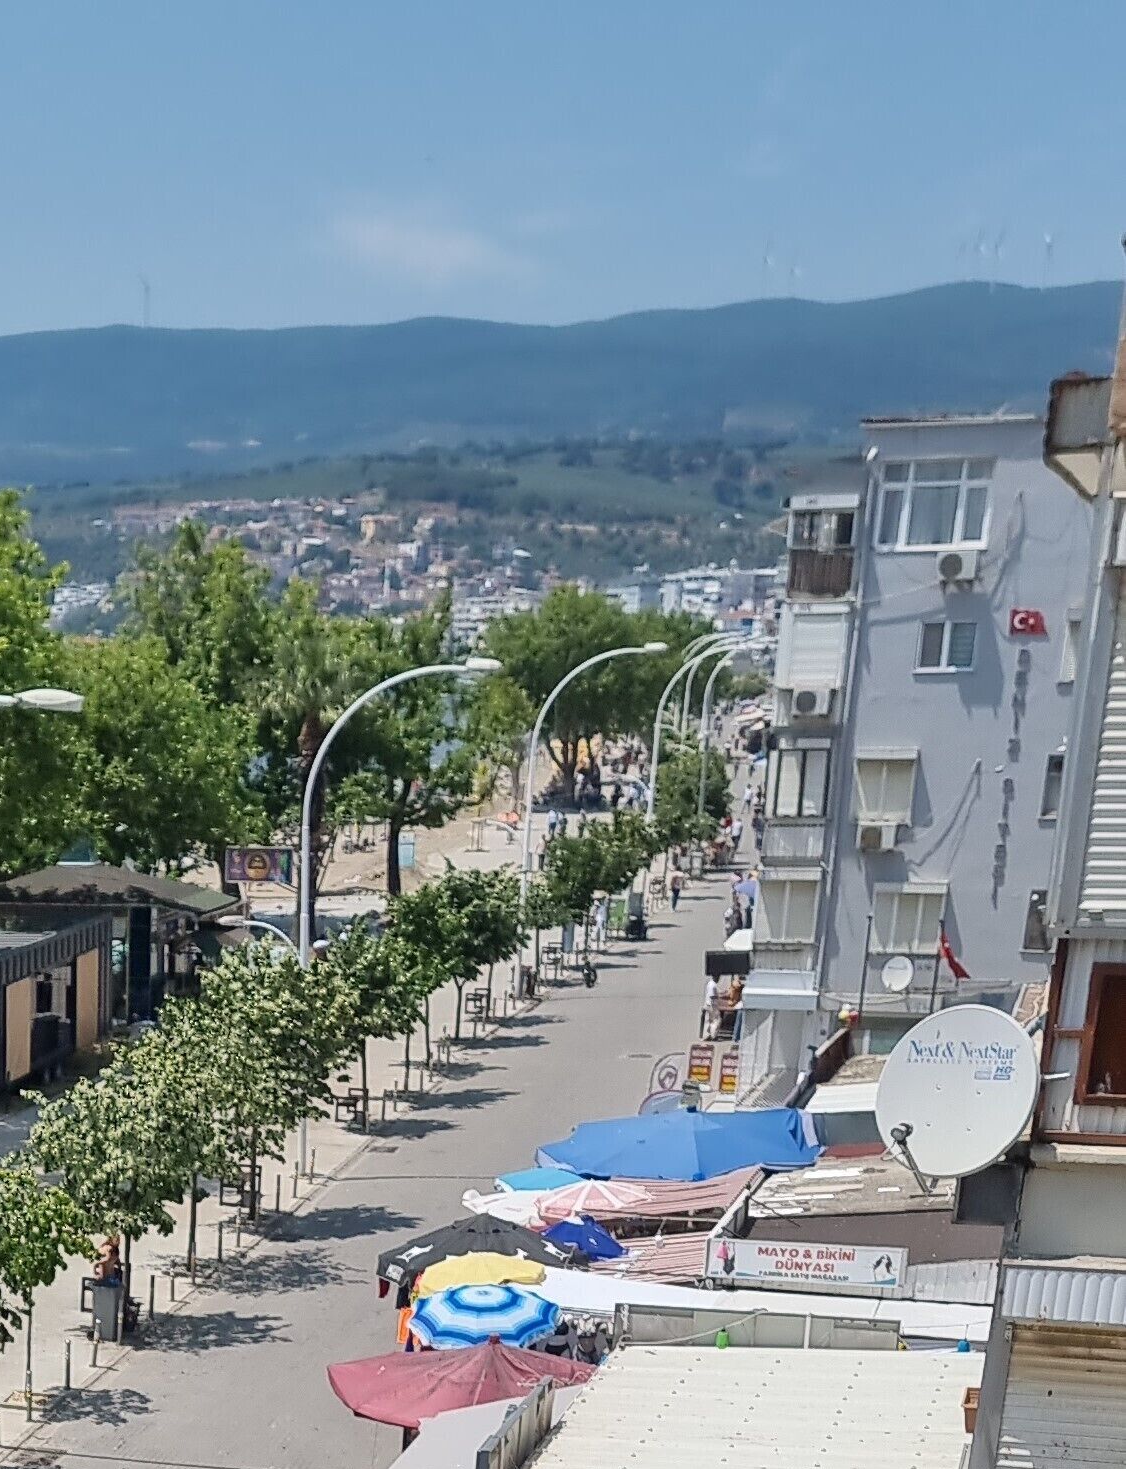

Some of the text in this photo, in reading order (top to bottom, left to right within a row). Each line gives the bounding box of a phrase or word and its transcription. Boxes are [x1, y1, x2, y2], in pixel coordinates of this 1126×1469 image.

[908, 1040, 1017, 1060] Next & NextStar
[757, 1246, 857, 1262] MAYO & BİKİNİ
[774, 1258, 835, 1272] DÜNYASI
